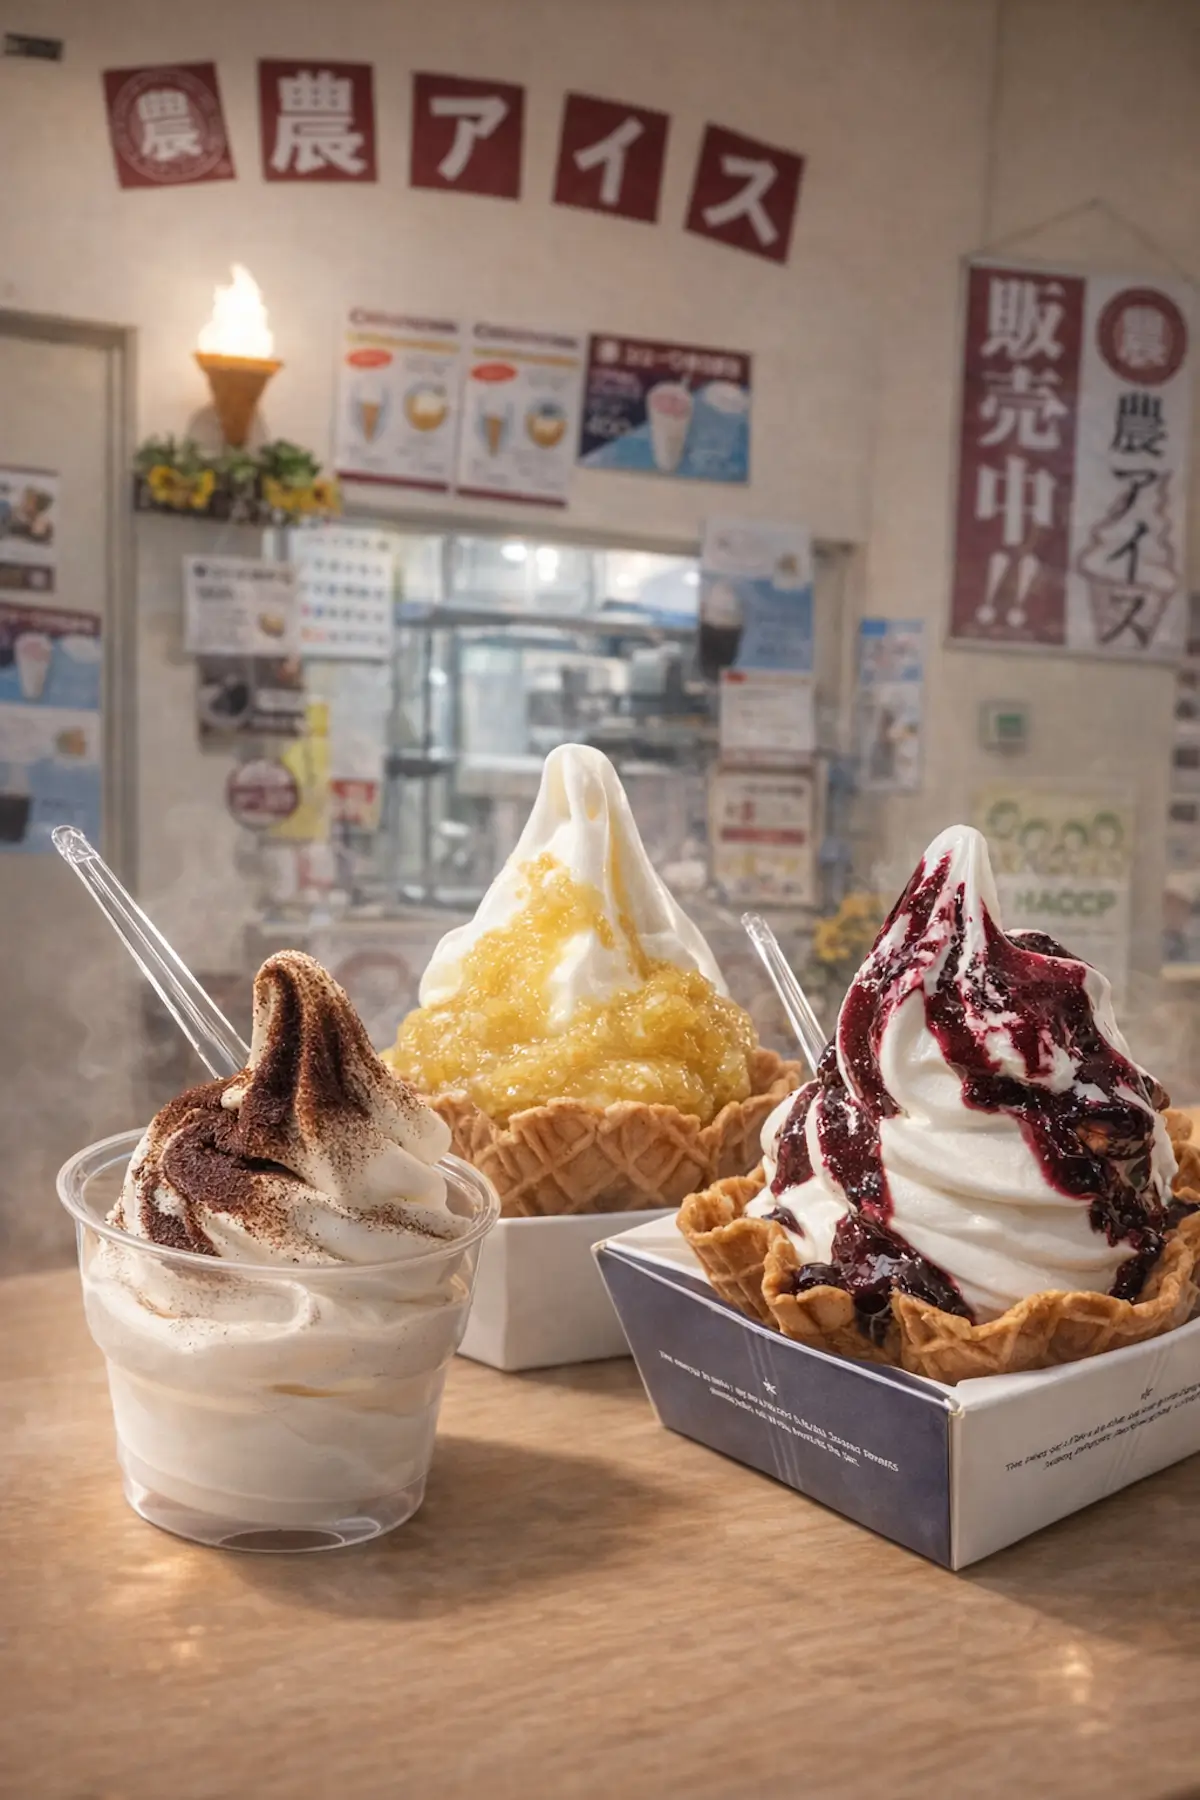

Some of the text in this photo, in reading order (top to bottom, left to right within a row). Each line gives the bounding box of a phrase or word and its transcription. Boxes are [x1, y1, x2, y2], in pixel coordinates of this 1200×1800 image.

[136, 89, 203, 161] 農
[1100, 392, 1170, 650] 農アイス
[1013, 888, 1117, 917] HACCP
